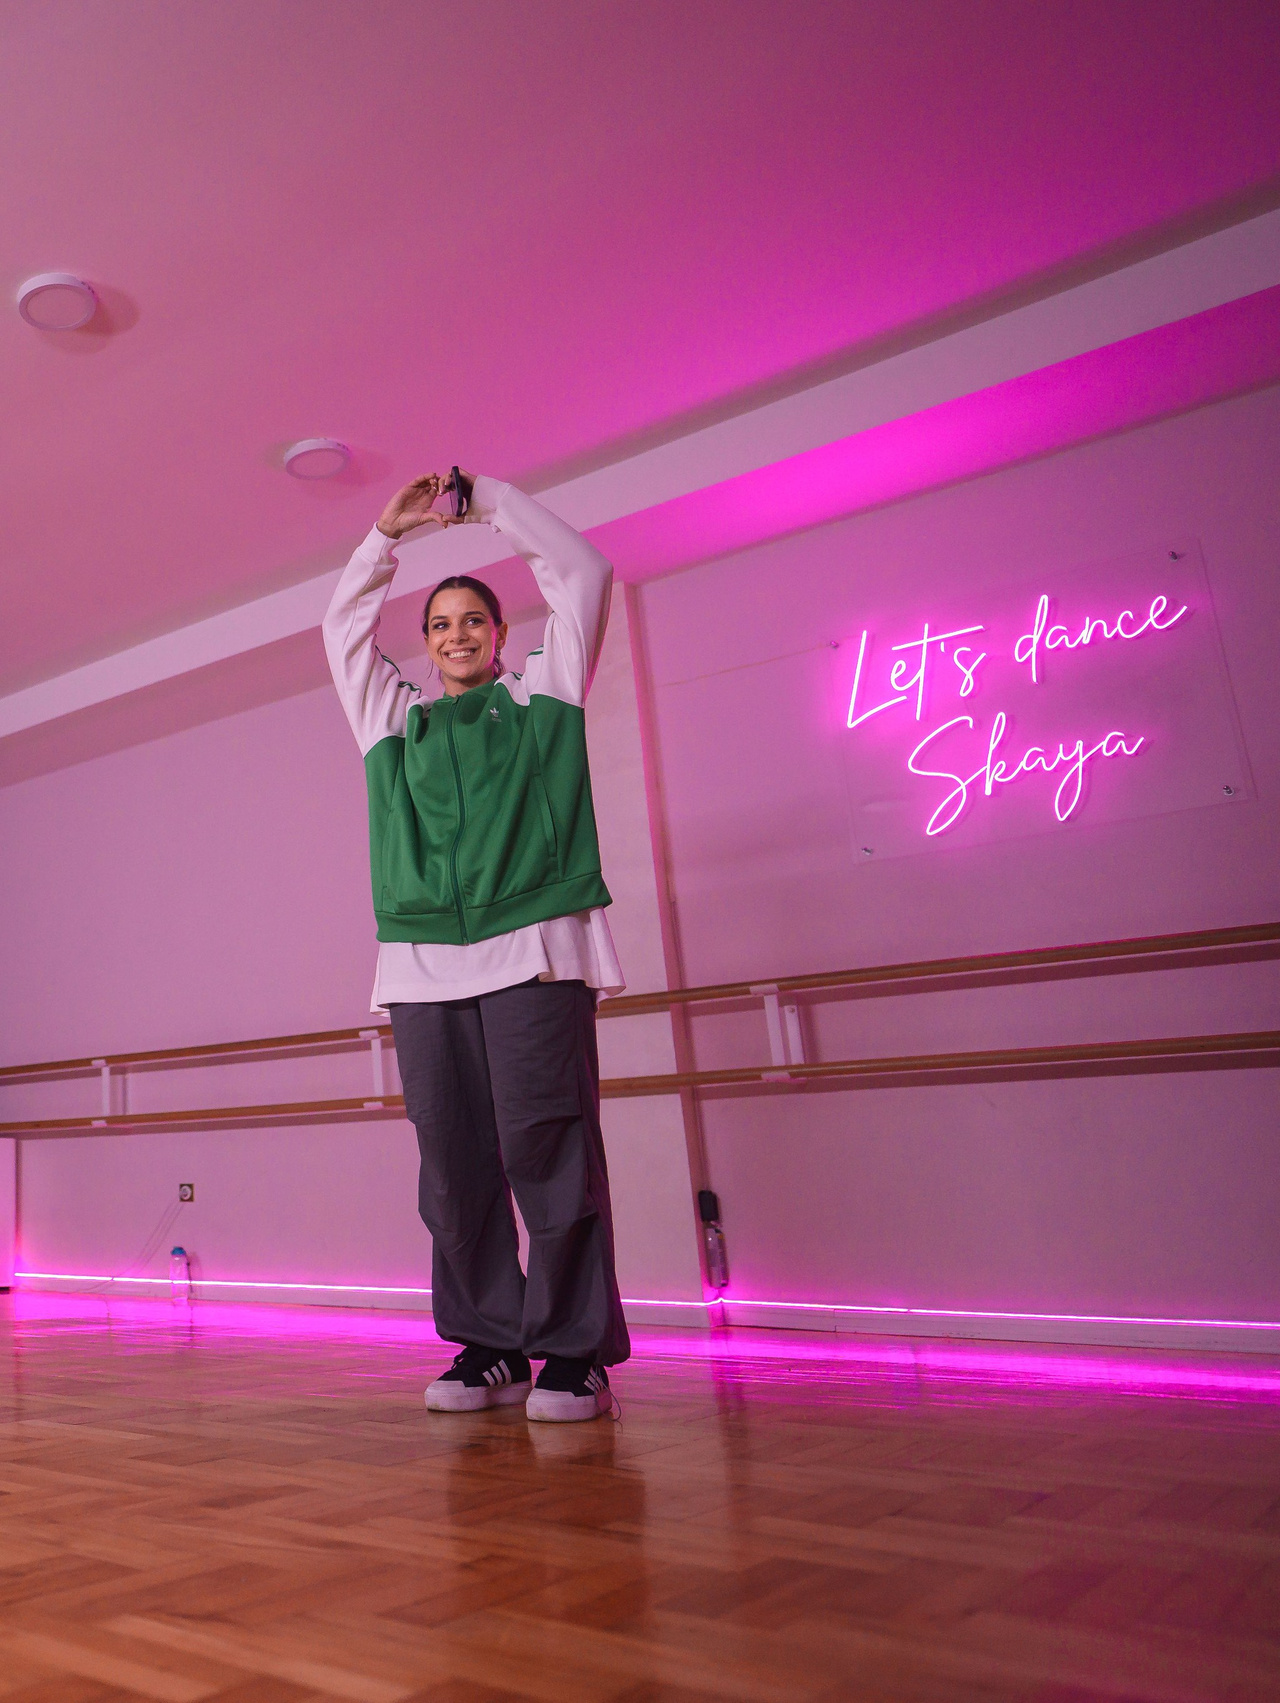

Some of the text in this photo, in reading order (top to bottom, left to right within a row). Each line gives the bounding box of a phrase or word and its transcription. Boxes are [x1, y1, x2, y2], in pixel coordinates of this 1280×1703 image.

[847, 594, 1188, 728] Let's dance
[907, 711, 1145, 836] Skaya
